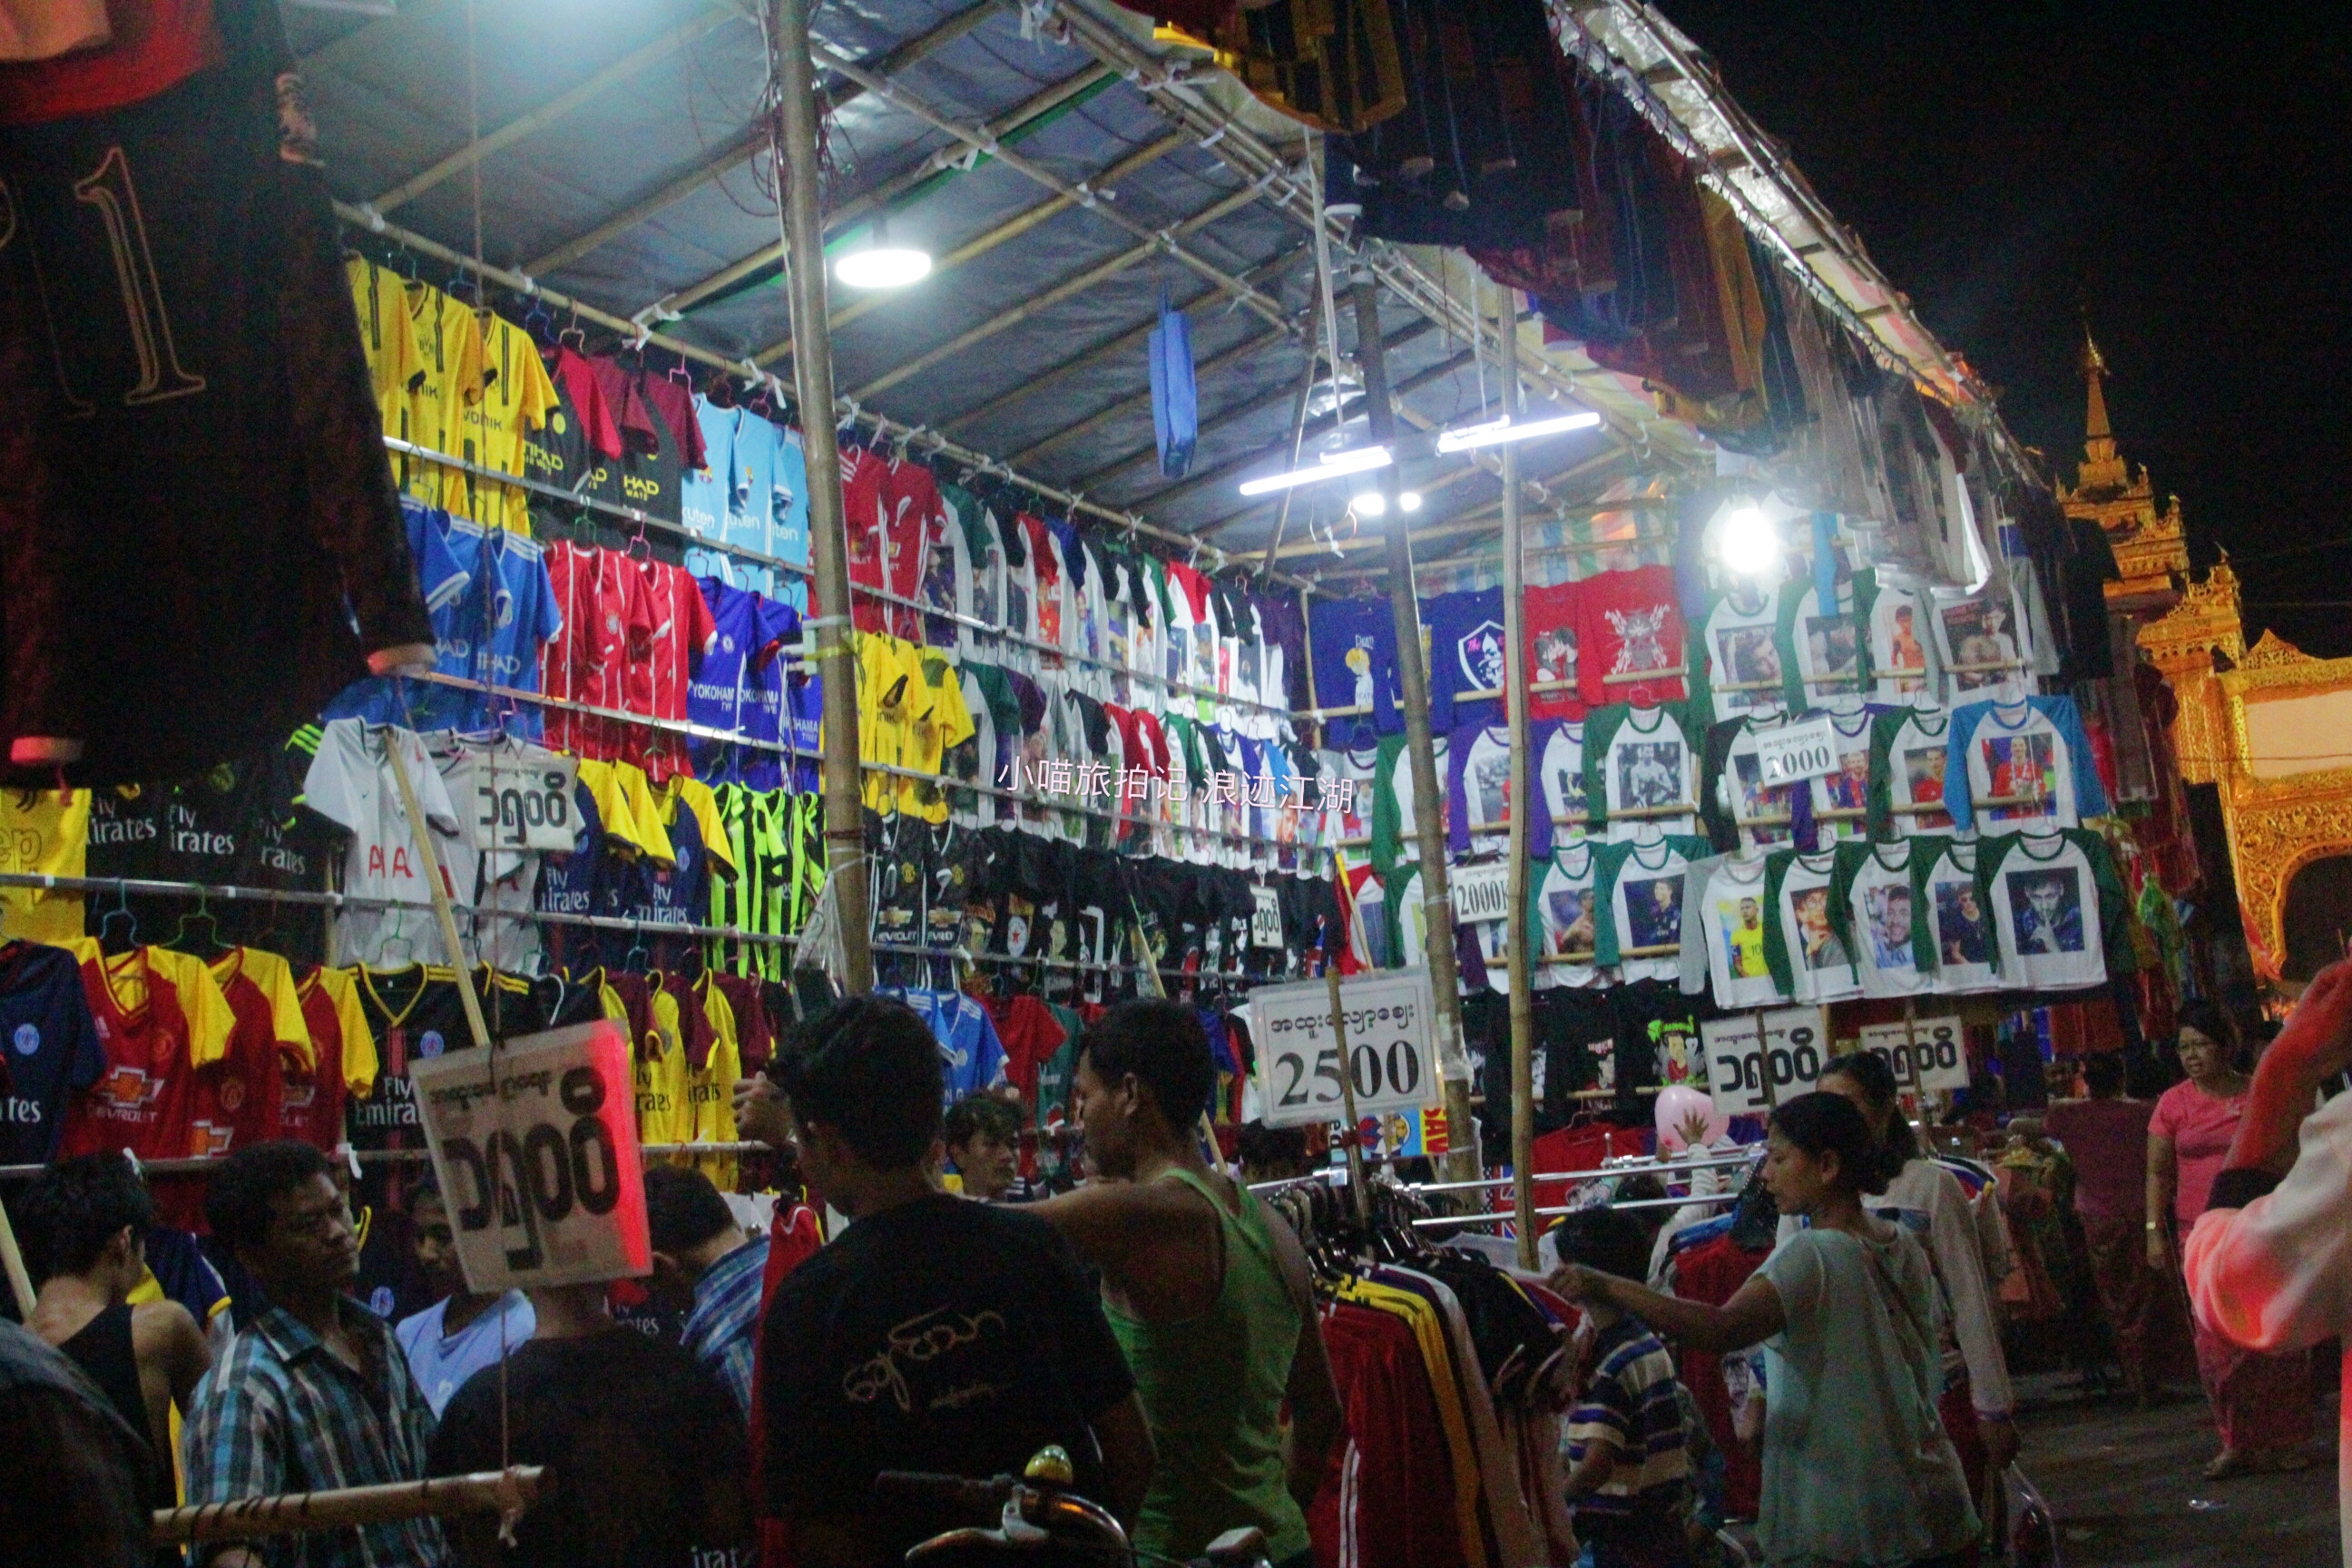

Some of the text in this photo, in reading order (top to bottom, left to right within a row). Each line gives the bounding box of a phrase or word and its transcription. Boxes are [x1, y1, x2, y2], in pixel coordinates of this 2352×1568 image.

[623, 475, 660, 496] HAD
[692, 683, 735, 702] YOKOHAM
[1766, 745, 1830, 780] 2000
[1275, 1040, 1419, 1107] 2500
[355, 1096, 418, 1127] Emira
